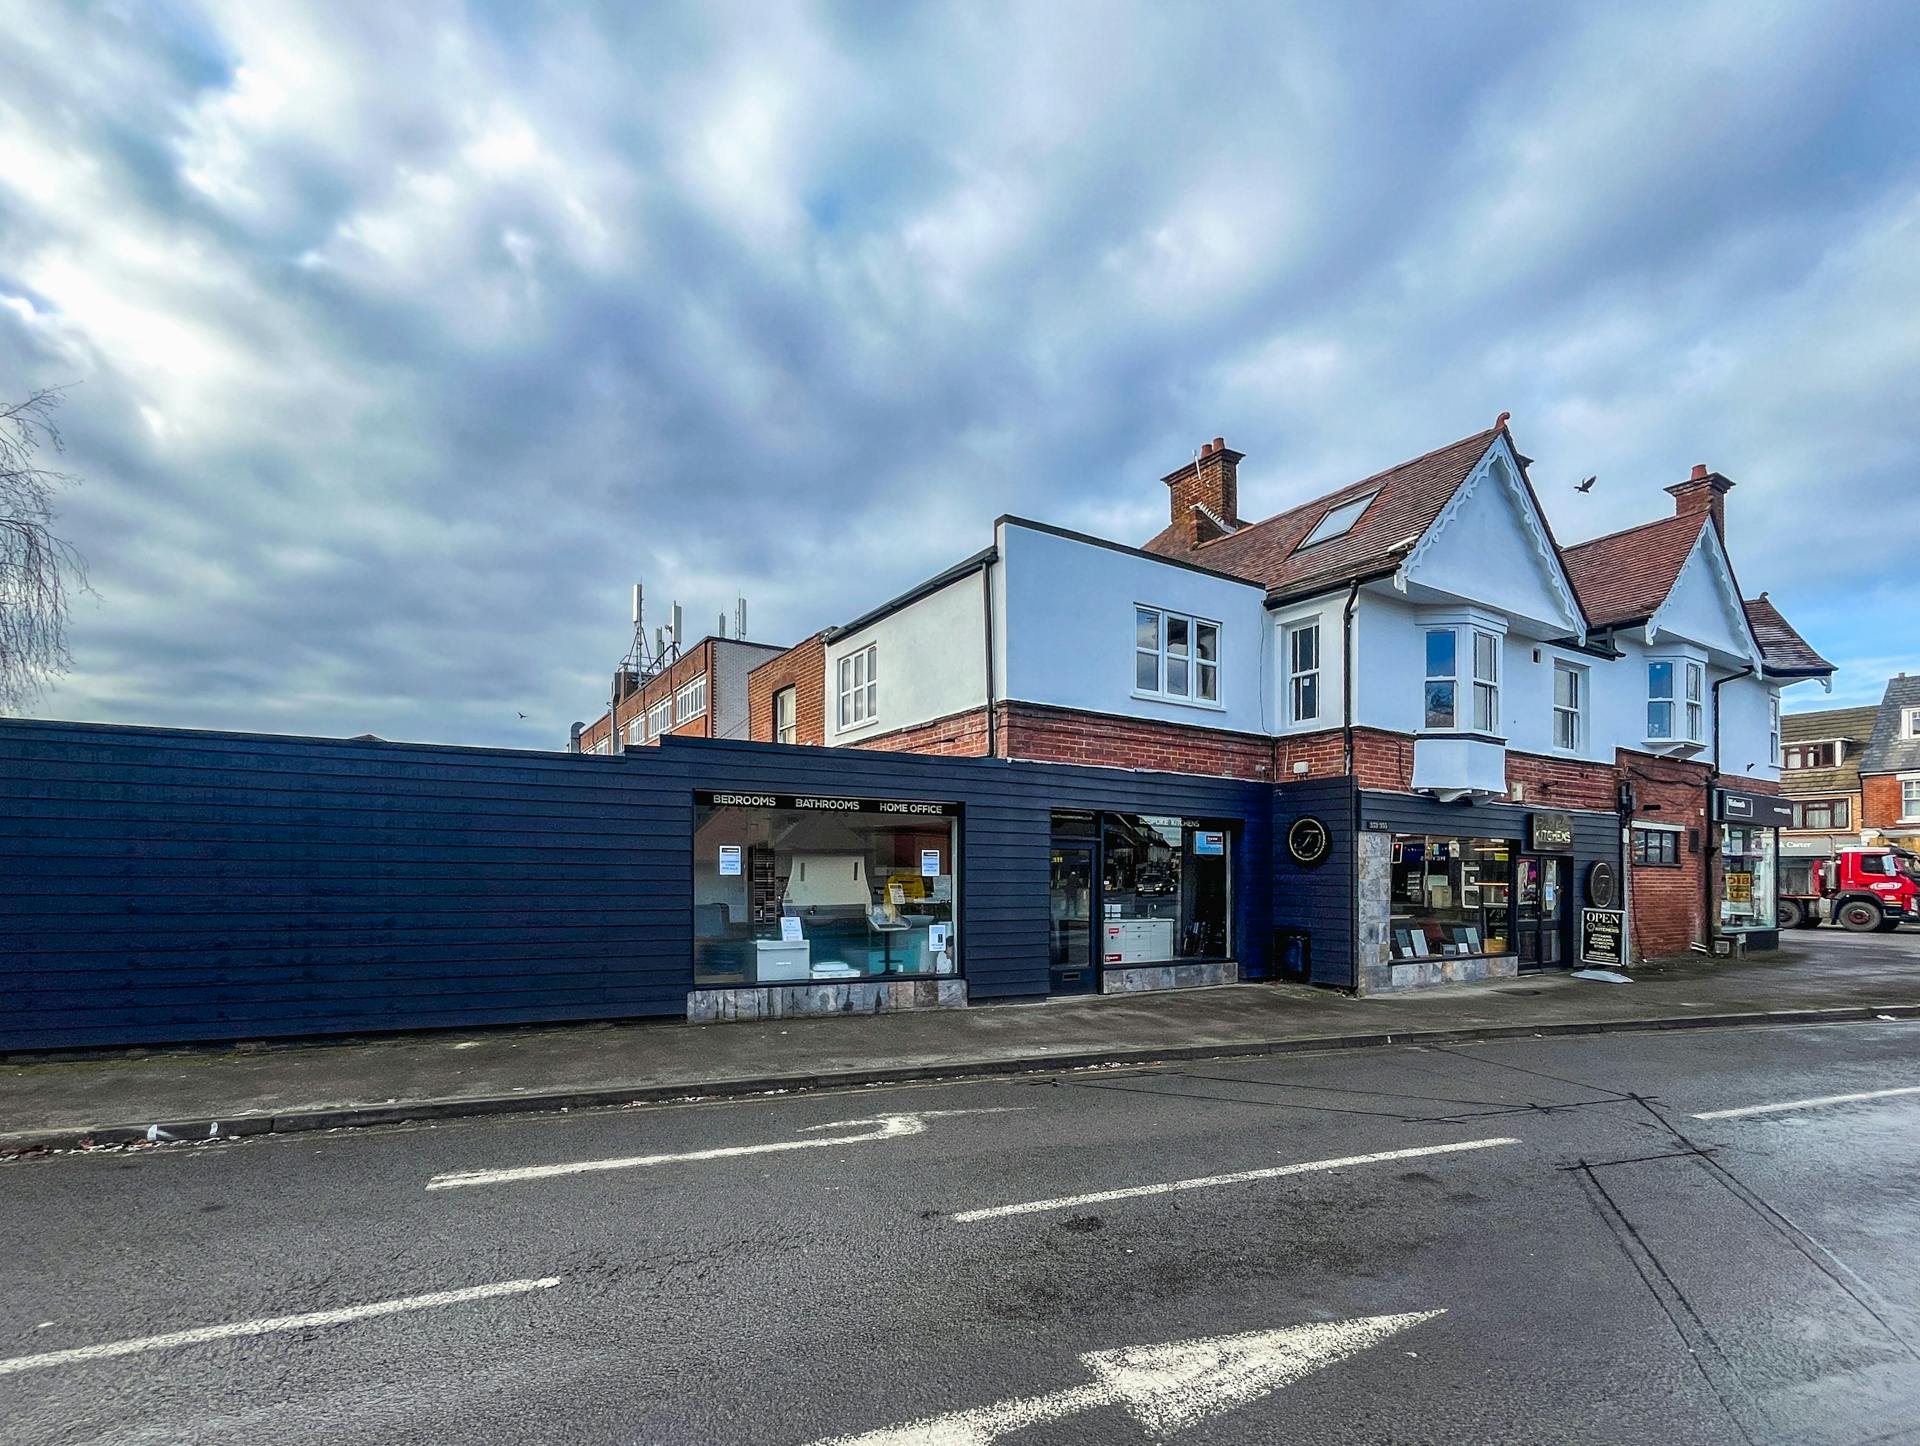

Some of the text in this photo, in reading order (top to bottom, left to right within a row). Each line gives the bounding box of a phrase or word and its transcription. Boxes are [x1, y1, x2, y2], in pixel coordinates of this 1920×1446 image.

[713, 794, 776, 807] BEDROOMS
[795, 798, 860, 811] BATHROOMS
[879, 802, 943, 814] HOME OFFICE
[1586, 912, 1620, 924] OPEN
